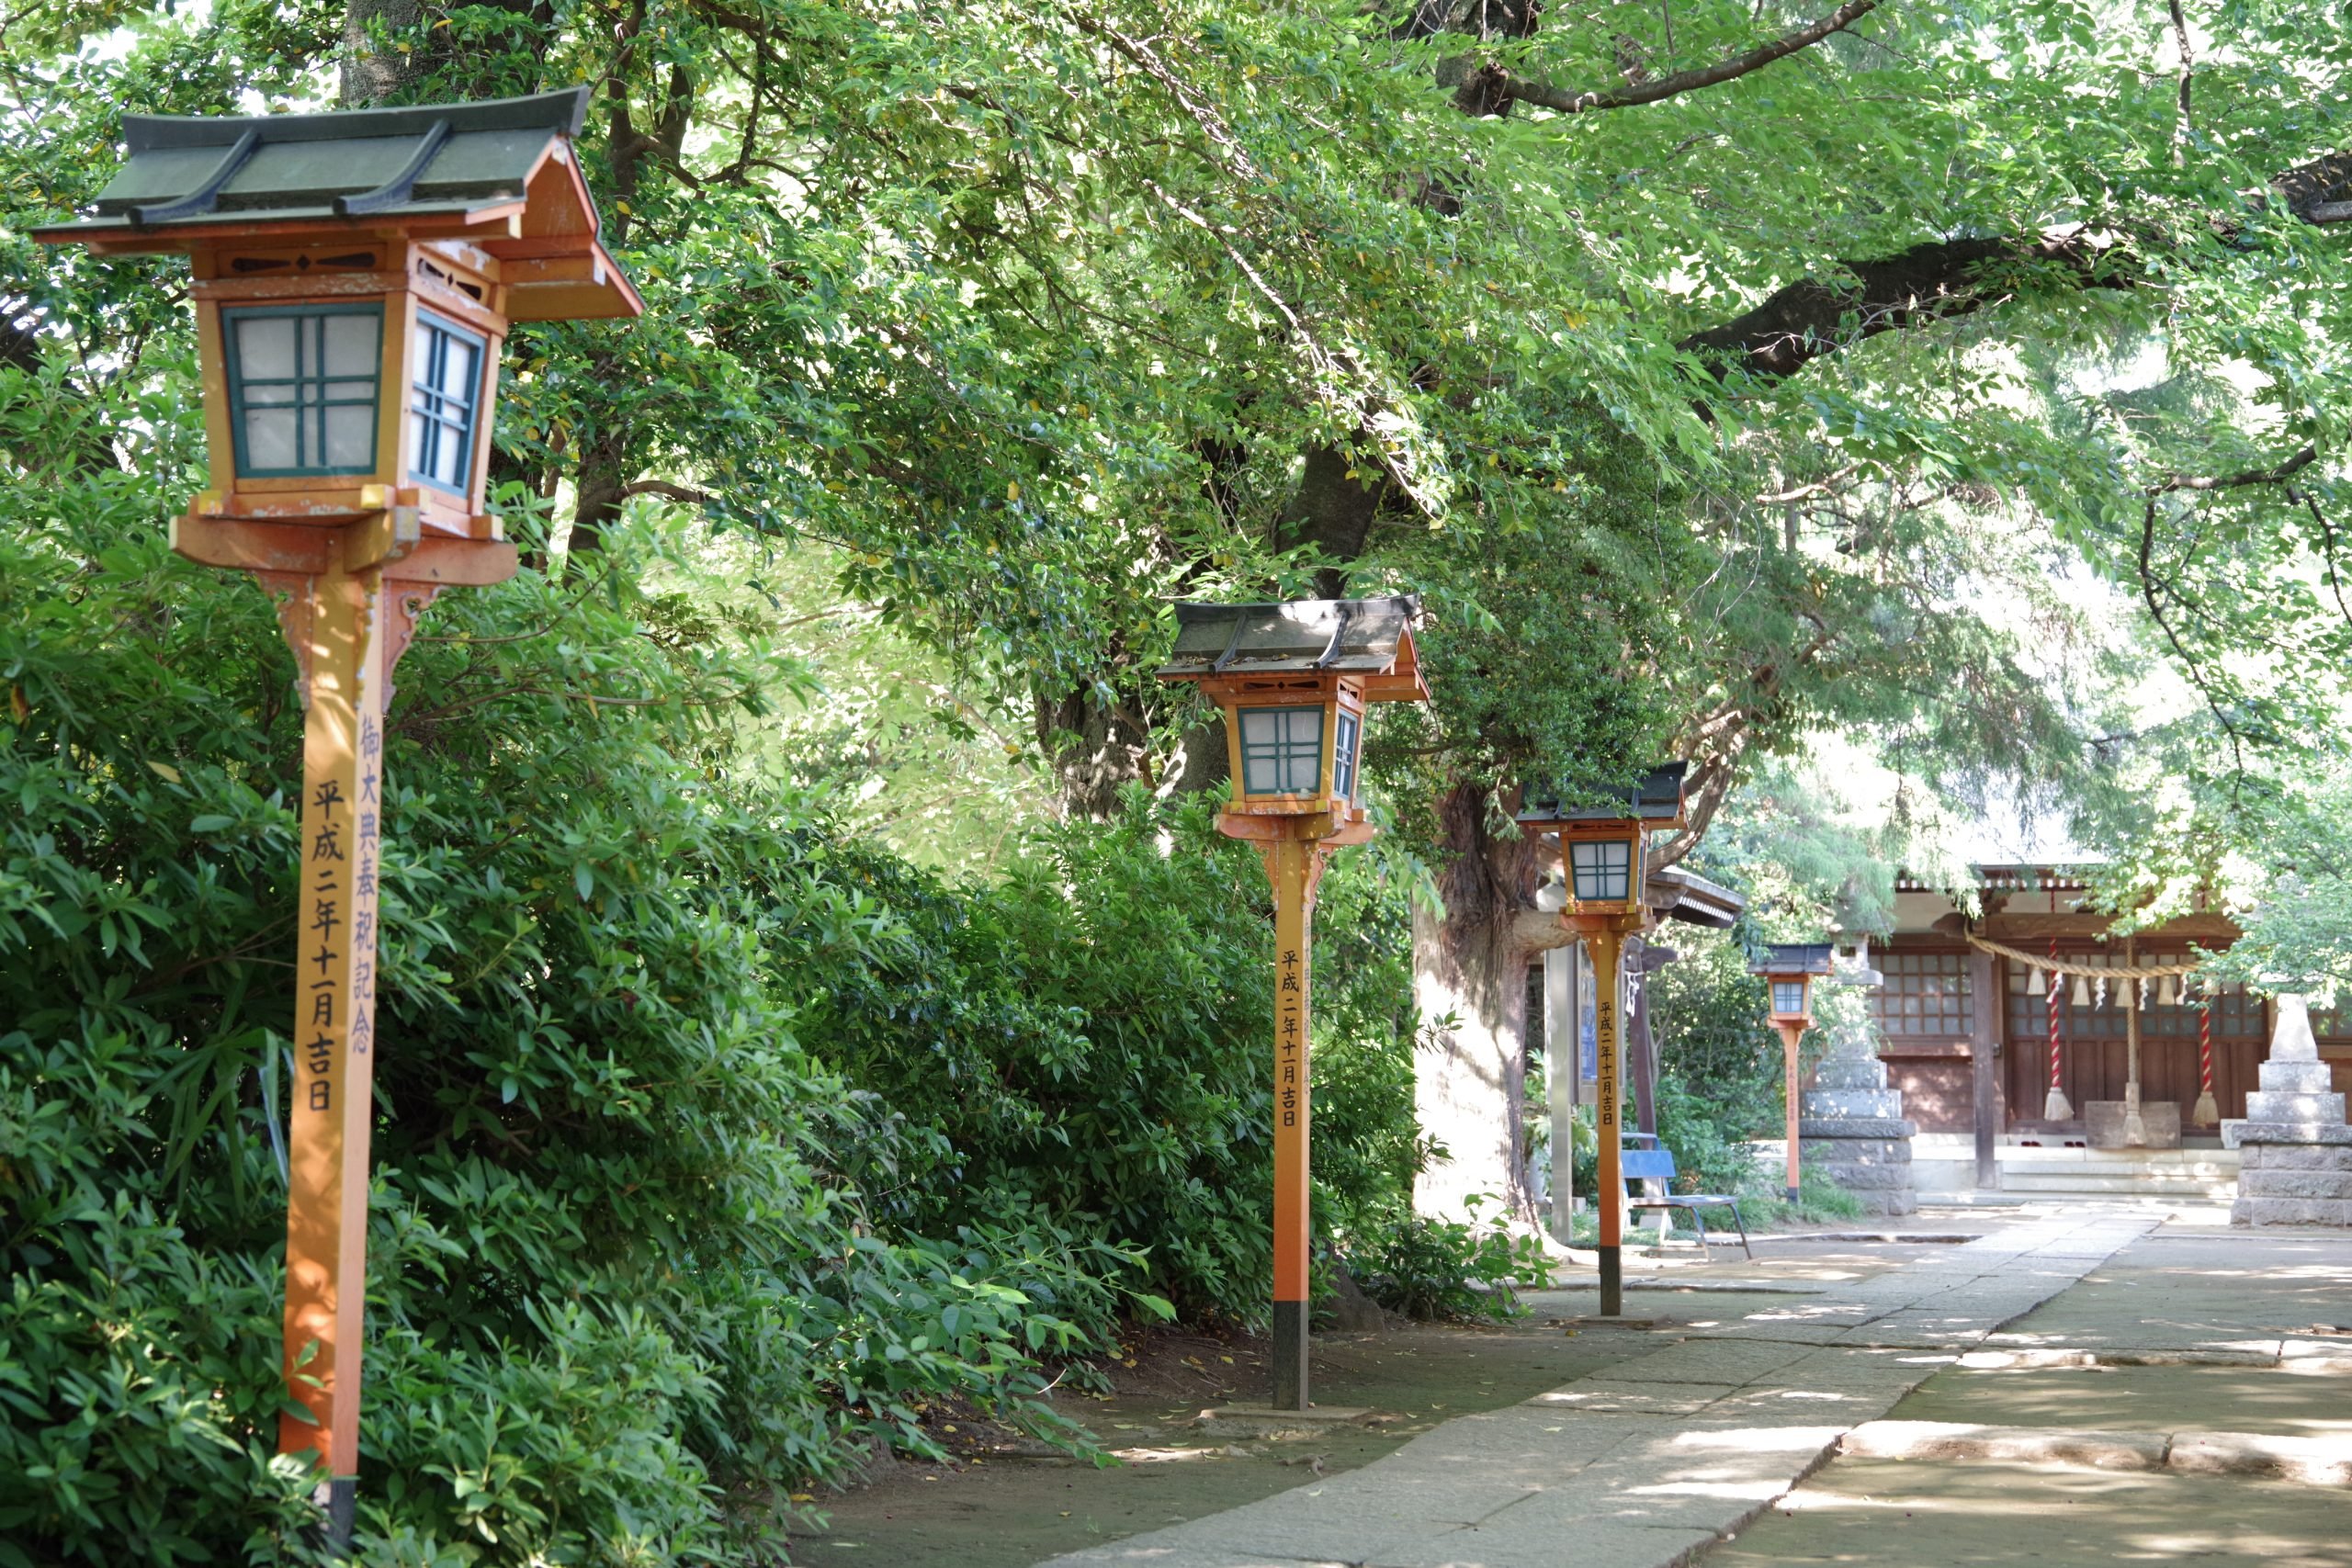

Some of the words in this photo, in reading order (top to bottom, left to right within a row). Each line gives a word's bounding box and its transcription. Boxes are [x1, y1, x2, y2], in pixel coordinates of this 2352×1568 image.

[307, 779, 345, 1111] 平成二年十一月吉日
[352, 713, 379, 1055] 御大典奉祝記念
[1282, 950, 1299, 1127] 平成二年十一月吉日
[1600, 1001, 1612, 1124] 平成二年十一月吉日
